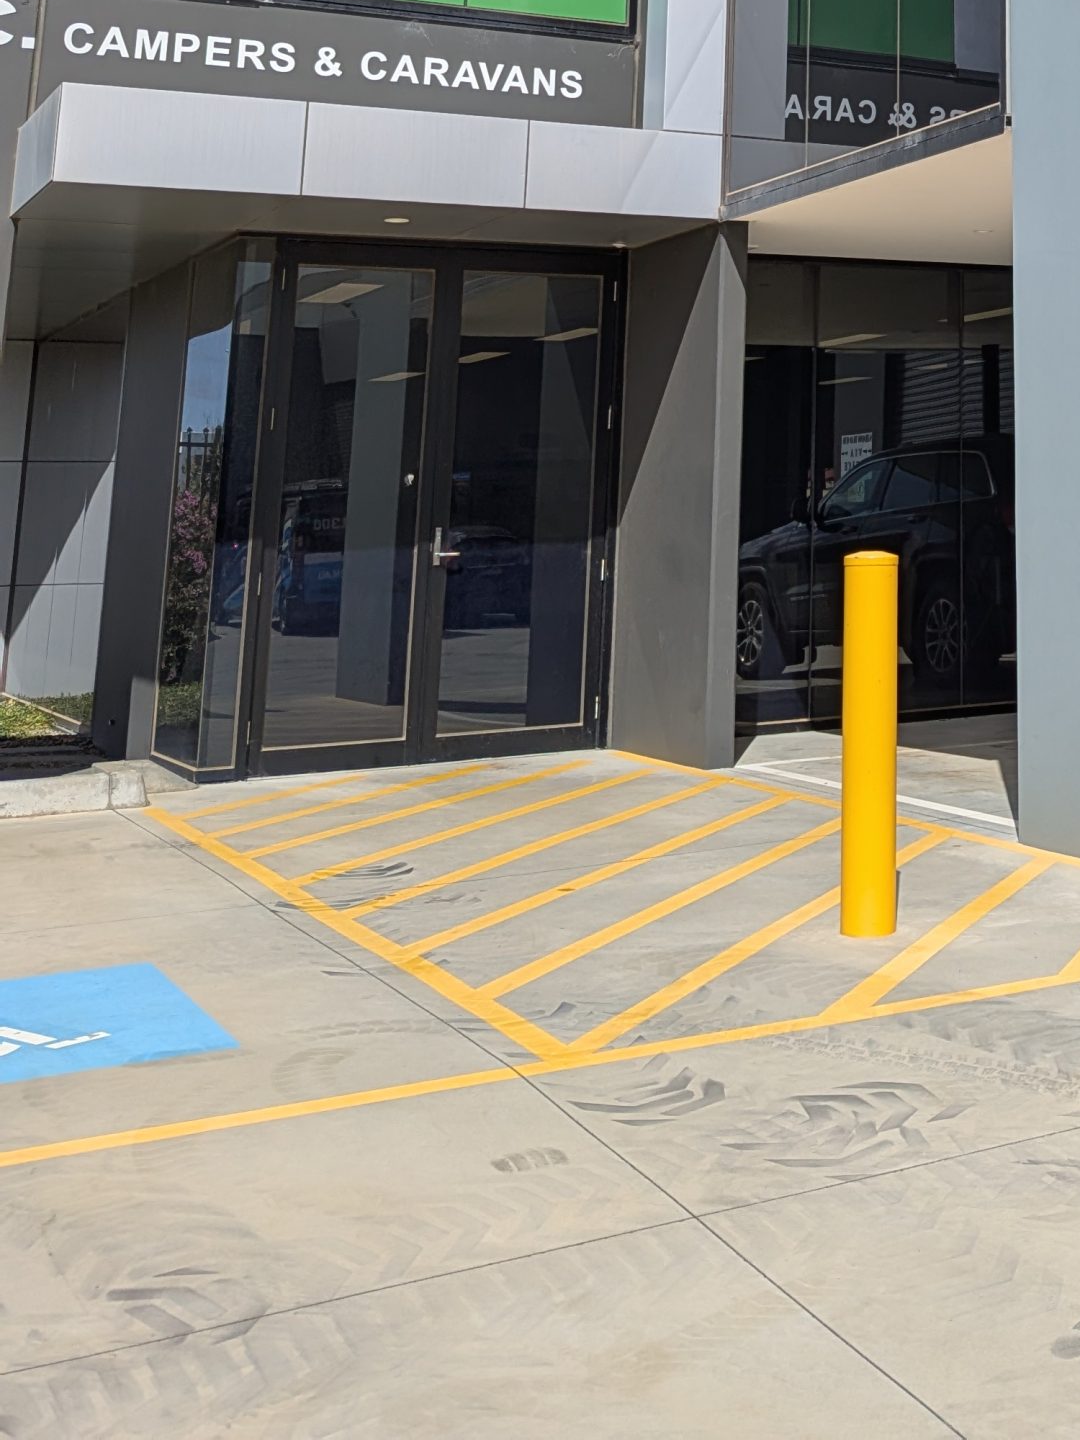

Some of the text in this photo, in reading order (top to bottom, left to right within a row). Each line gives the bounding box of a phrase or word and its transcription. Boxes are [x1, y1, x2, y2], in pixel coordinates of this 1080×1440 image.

[63, 22, 296, 73] CAMPERS
[314, 46, 342, 77] &
[360, 51, 583, 99] CARAVANS
